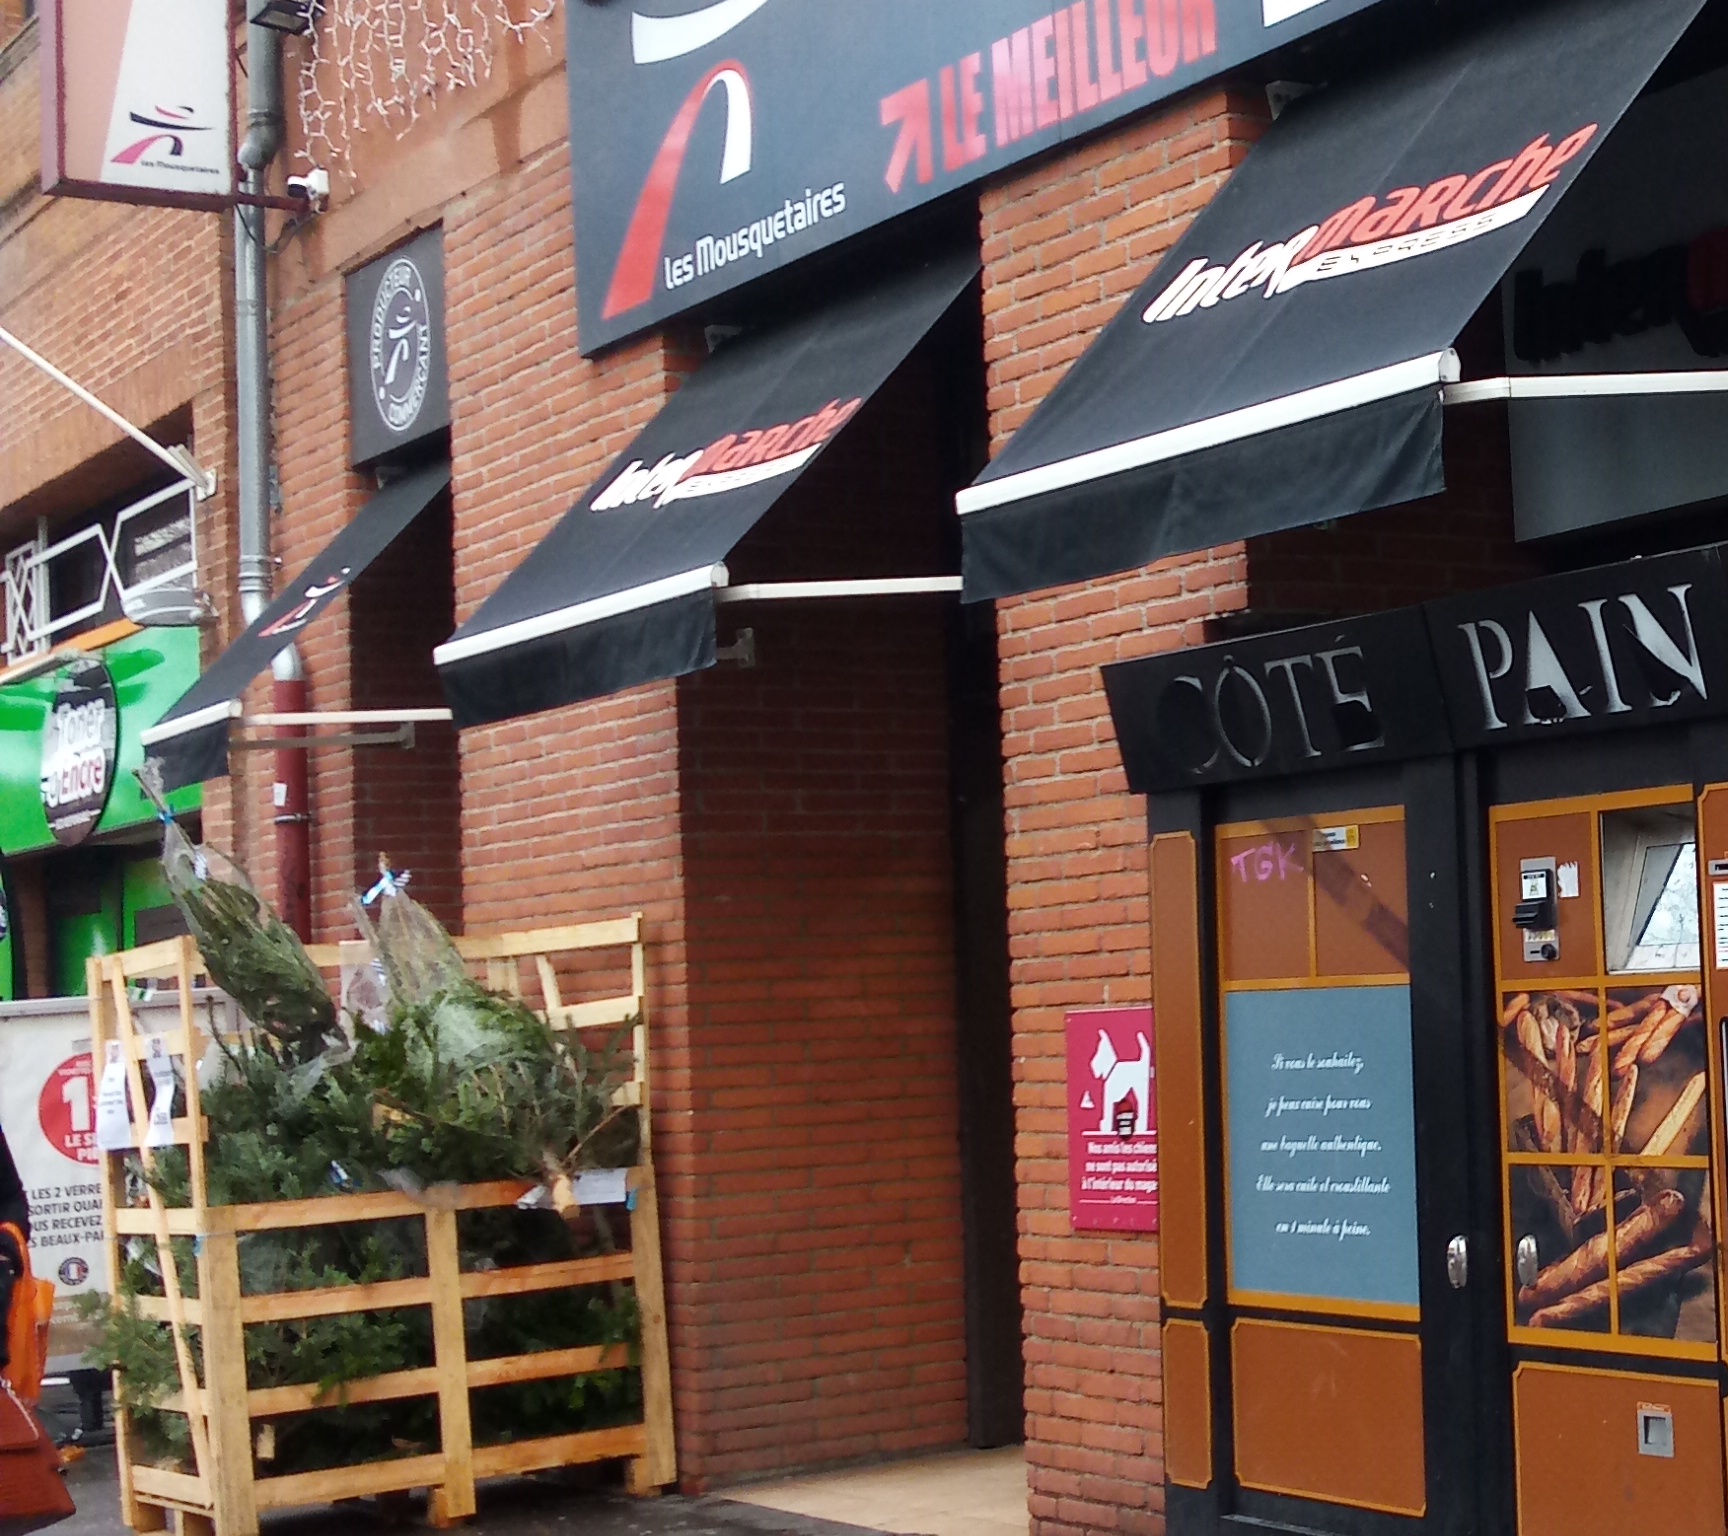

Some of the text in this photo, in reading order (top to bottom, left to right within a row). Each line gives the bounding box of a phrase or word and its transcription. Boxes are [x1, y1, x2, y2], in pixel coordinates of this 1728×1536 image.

[937, 52, 987, 167] LE
[664, 182, 846, 290] les Mousquetaires
[1458, 584, 1709, 732] PAIN
[1231, 841, 1304, 882] TGK
[52, 1214, 102, 1230] RECEVEZ
[54, 1186, 61, 1198] 2
